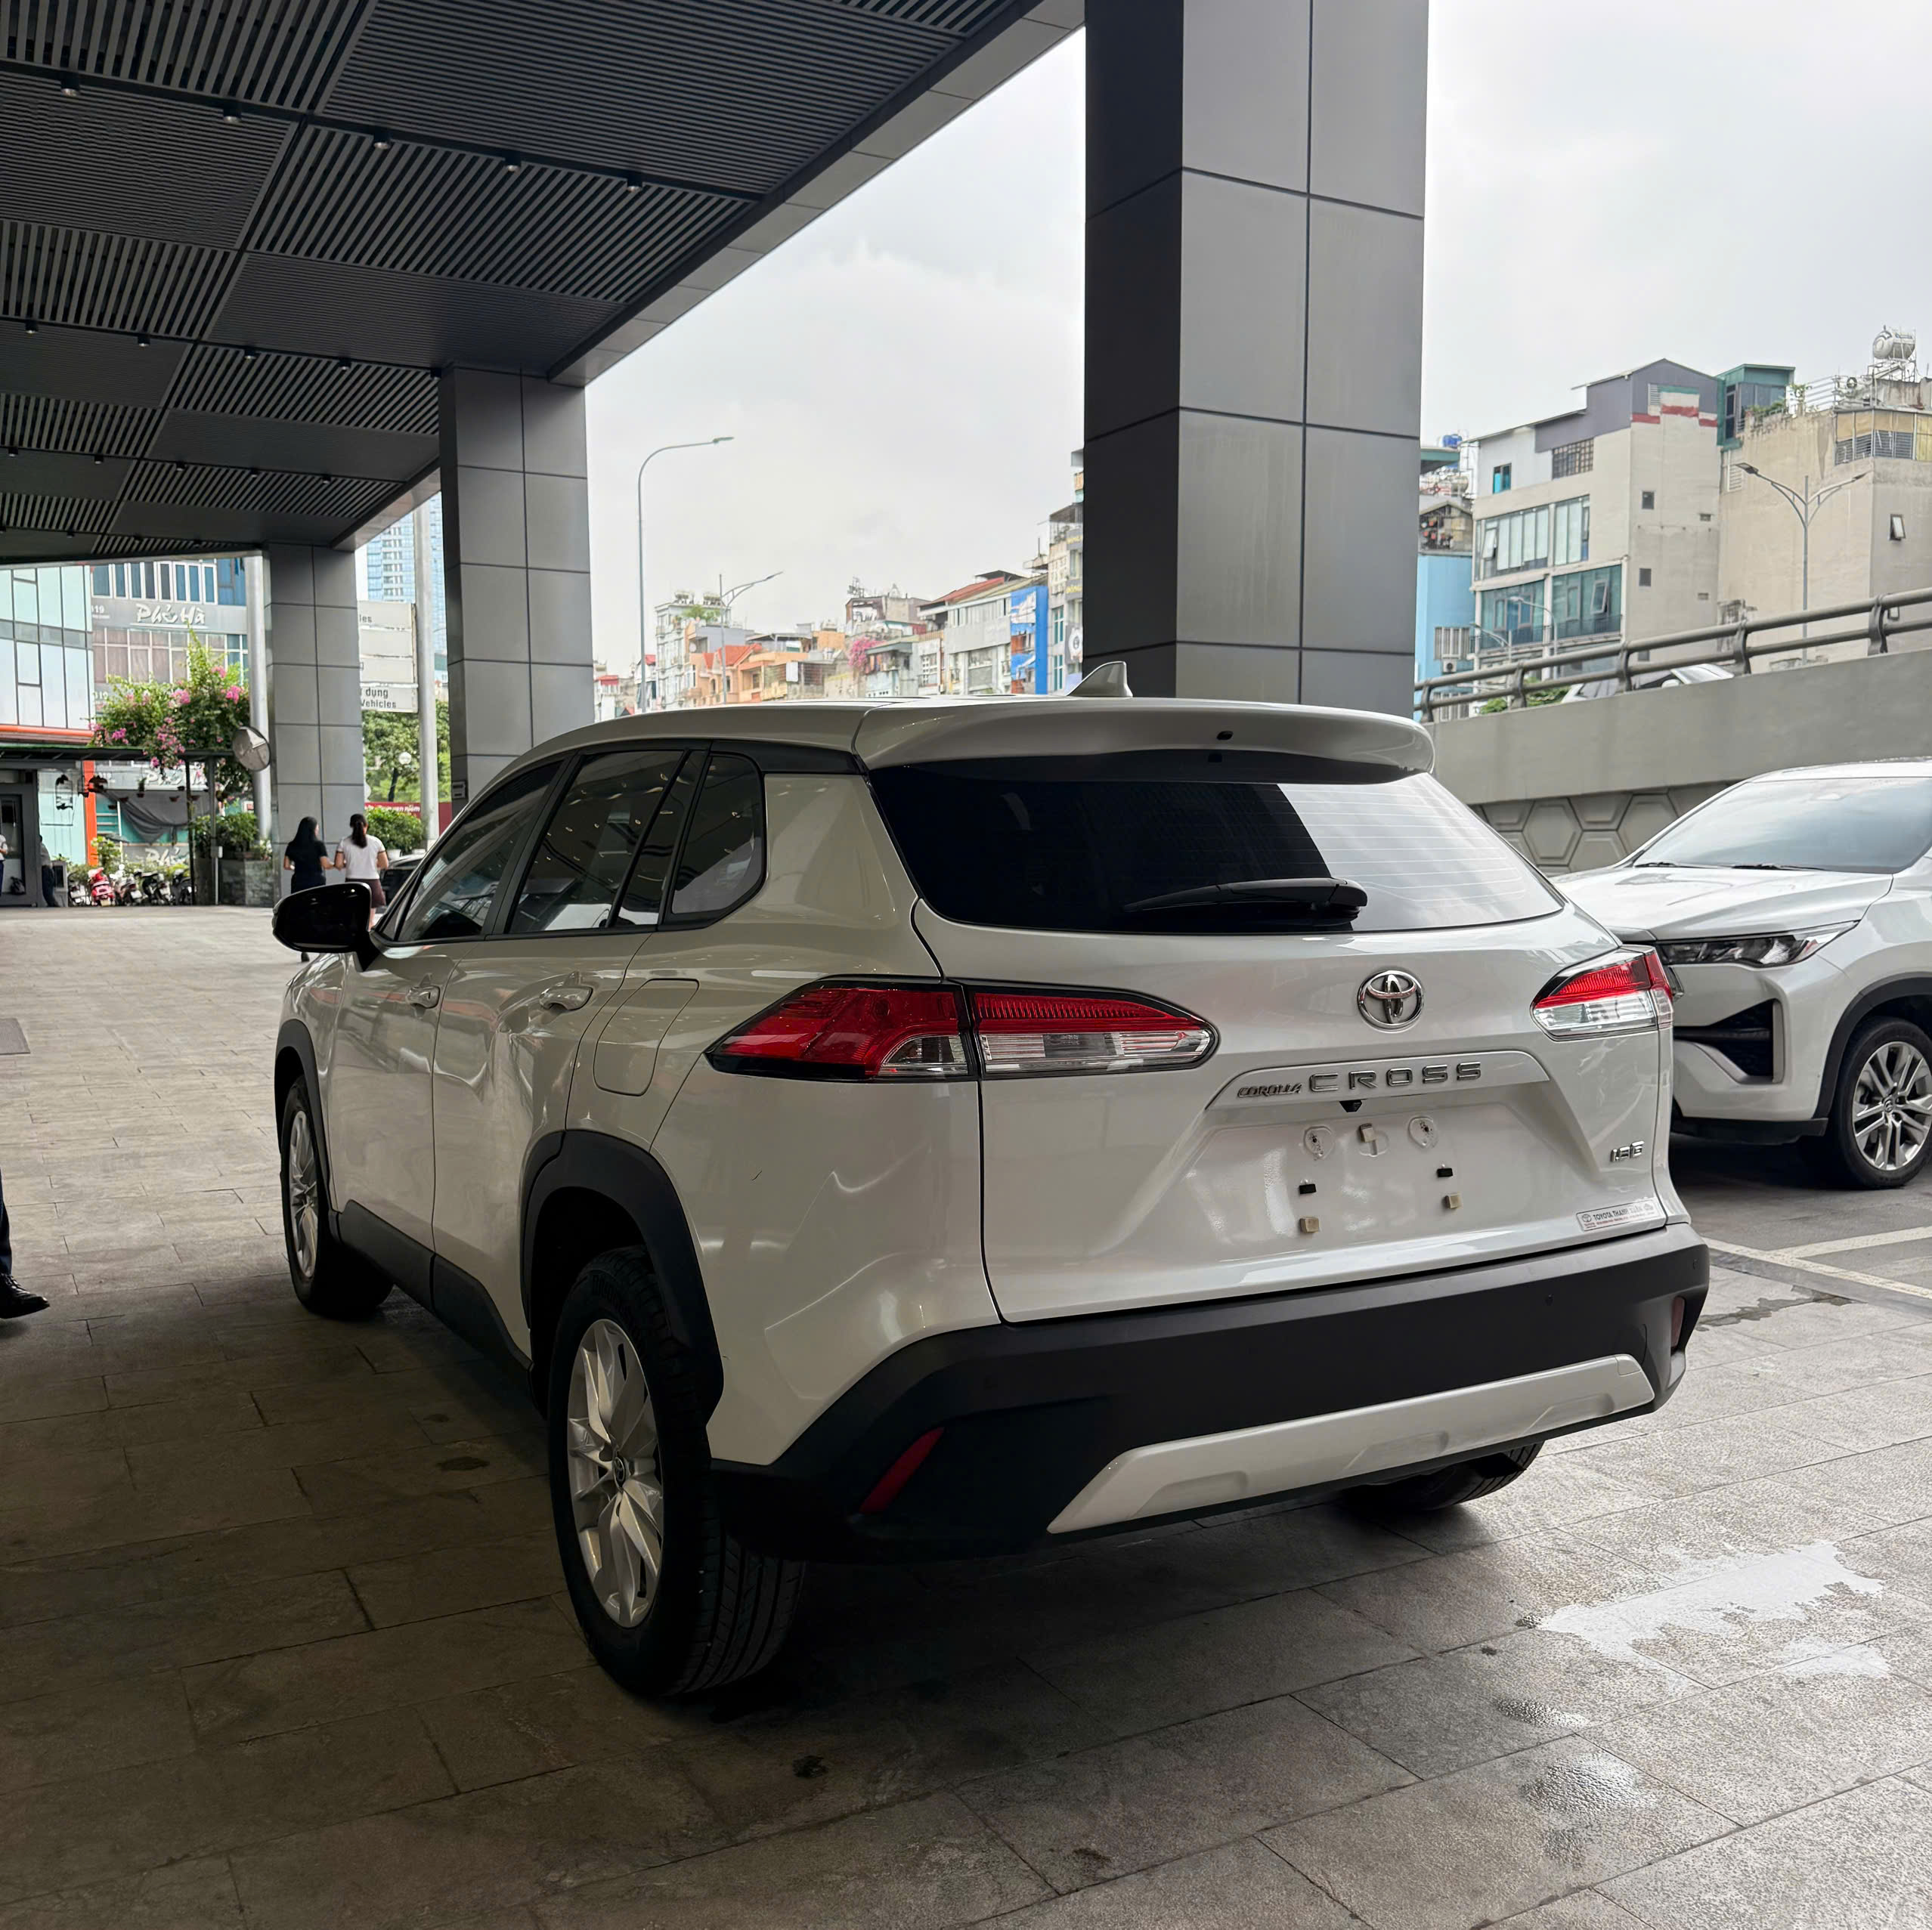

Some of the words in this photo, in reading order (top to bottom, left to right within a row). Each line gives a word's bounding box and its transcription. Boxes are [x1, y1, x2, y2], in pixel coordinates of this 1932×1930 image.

[180, 605, 206, 625] Hà
[365, 687, 389, 699] dụng
[1237, 1082, 1302, 1097] COROLLA
[1308, 1061, 1482, 1093] CROSS
[1593, 1211, 1613, 1221] TOYOTA
